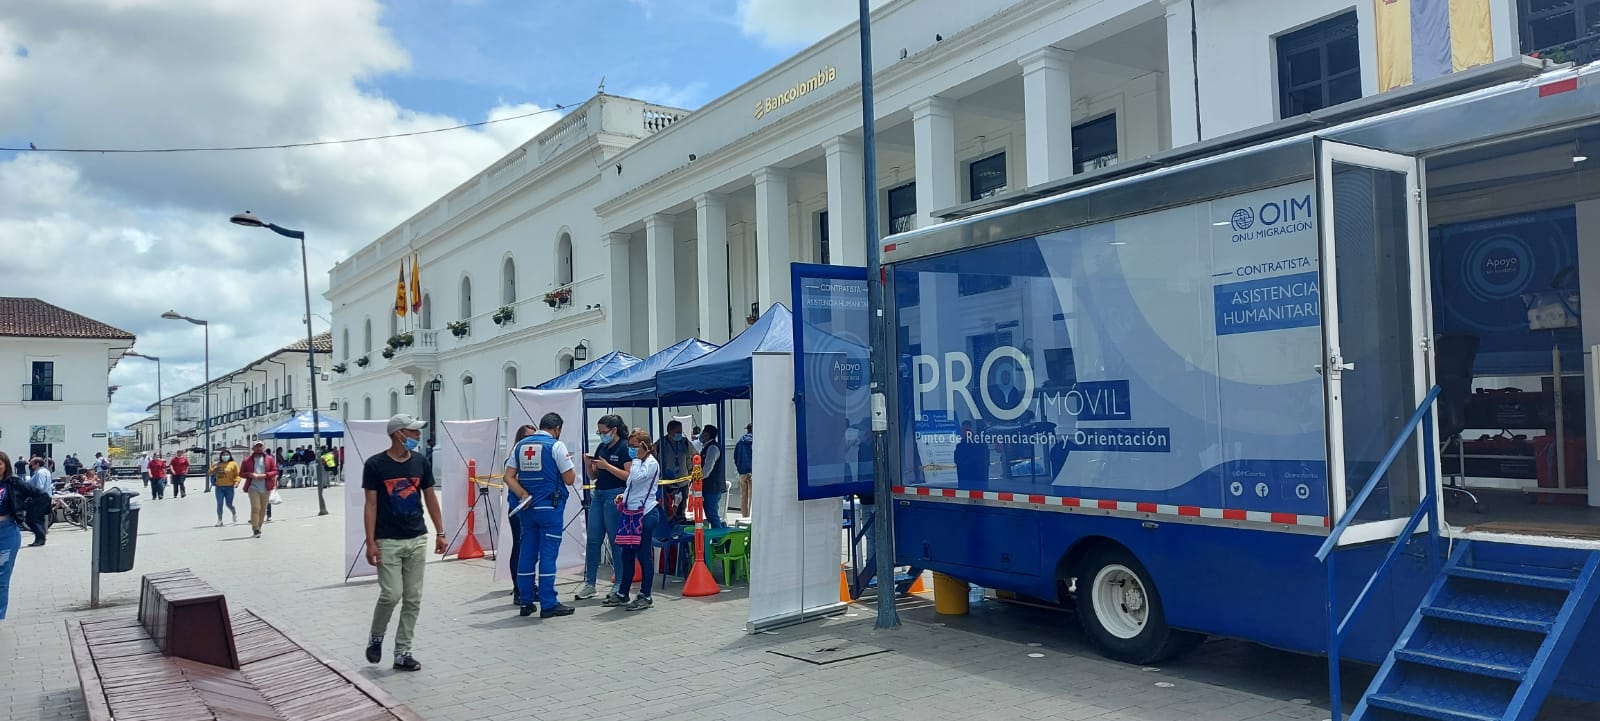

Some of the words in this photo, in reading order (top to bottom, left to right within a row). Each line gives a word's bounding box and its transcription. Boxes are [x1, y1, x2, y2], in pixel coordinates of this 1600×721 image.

[765, 66, 837, 113] Bancolombia
[1259, 194, 1312, 225] OIM
[1231, 231, 1254, 243] ONU
[1256, 221, 1312, 240] MIGRACIÓN
[1236, 257, 1311, 277] CONTRATISTA
[1486, 257, 1518, 269] Apoyo
[820, 284, 861, 293] CONTRATISTA
[1232, 281, 1319, 305] ASISTENCIA
[1223, 302, 1319, 325] HUMANITARI
[833, 360, 861, 374] Apoyo
[912, 345, 1035, 421] PRO
[915, 431, 945, 443] Punto
[950, 431, 962, 443] de
[966, 429, 1056, 445] Referenciación
[1061, 434, 1069, 448] y
[1074, 430, 1167, 447] Orientación
